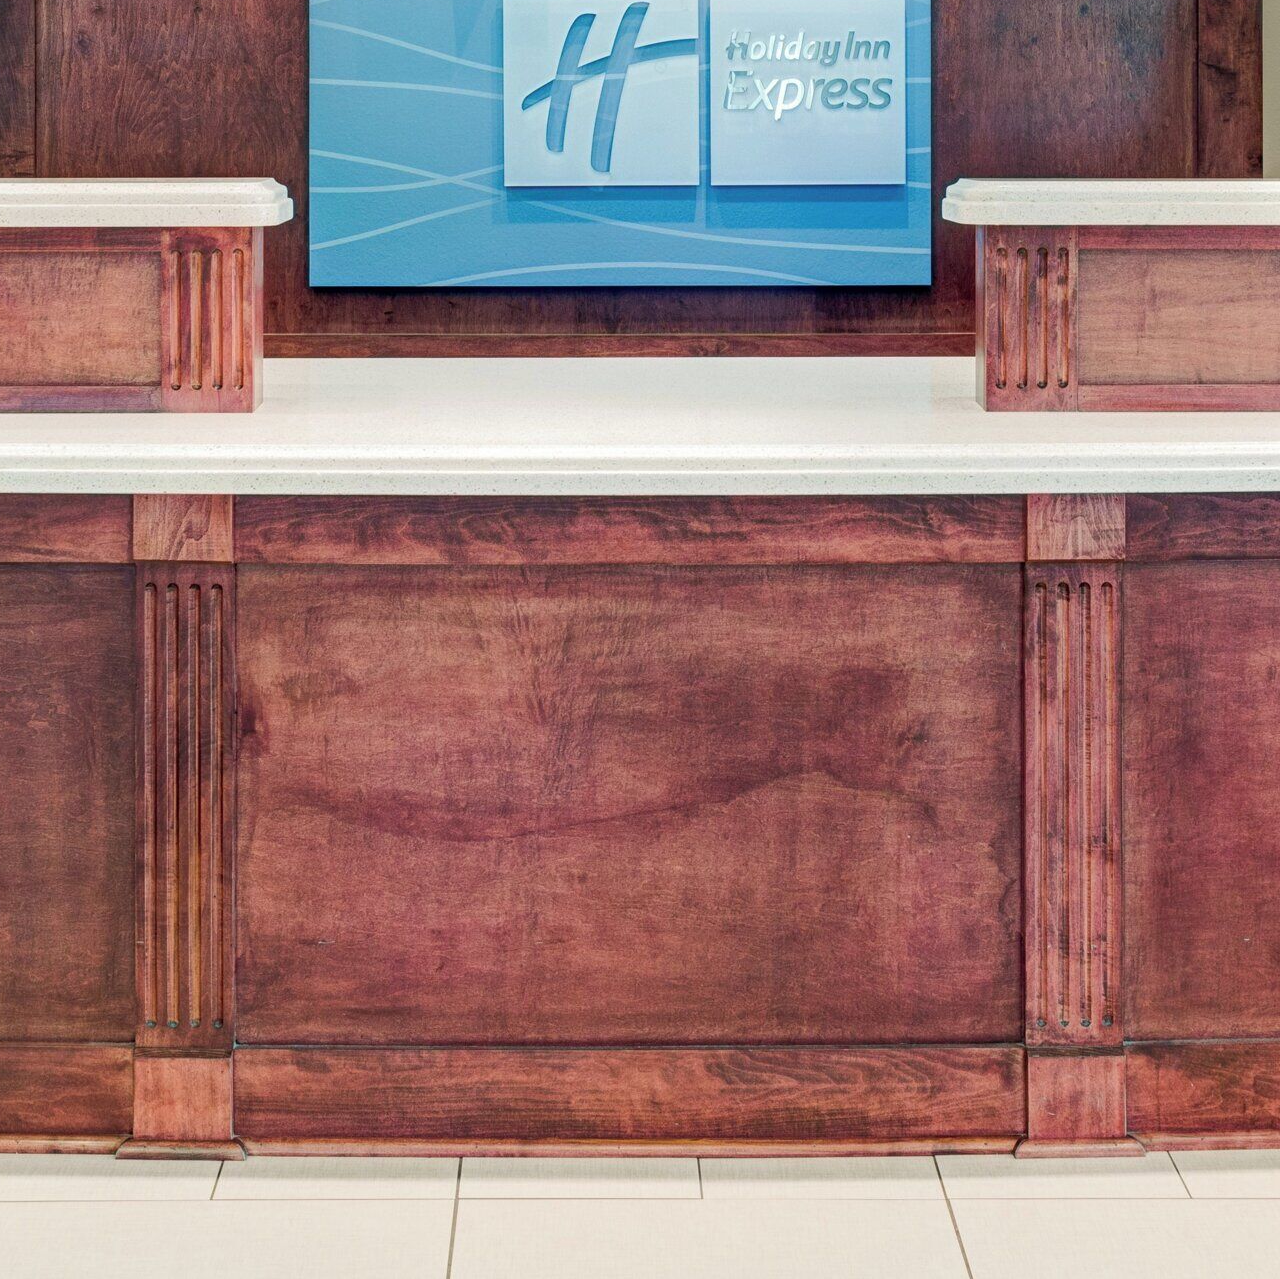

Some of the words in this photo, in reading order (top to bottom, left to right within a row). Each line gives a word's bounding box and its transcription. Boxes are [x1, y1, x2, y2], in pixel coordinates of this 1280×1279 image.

[725, 29, 841, 67] Holiday
[844, 31, 891, 60] Inn
[723, 70, 893, 121] Express
